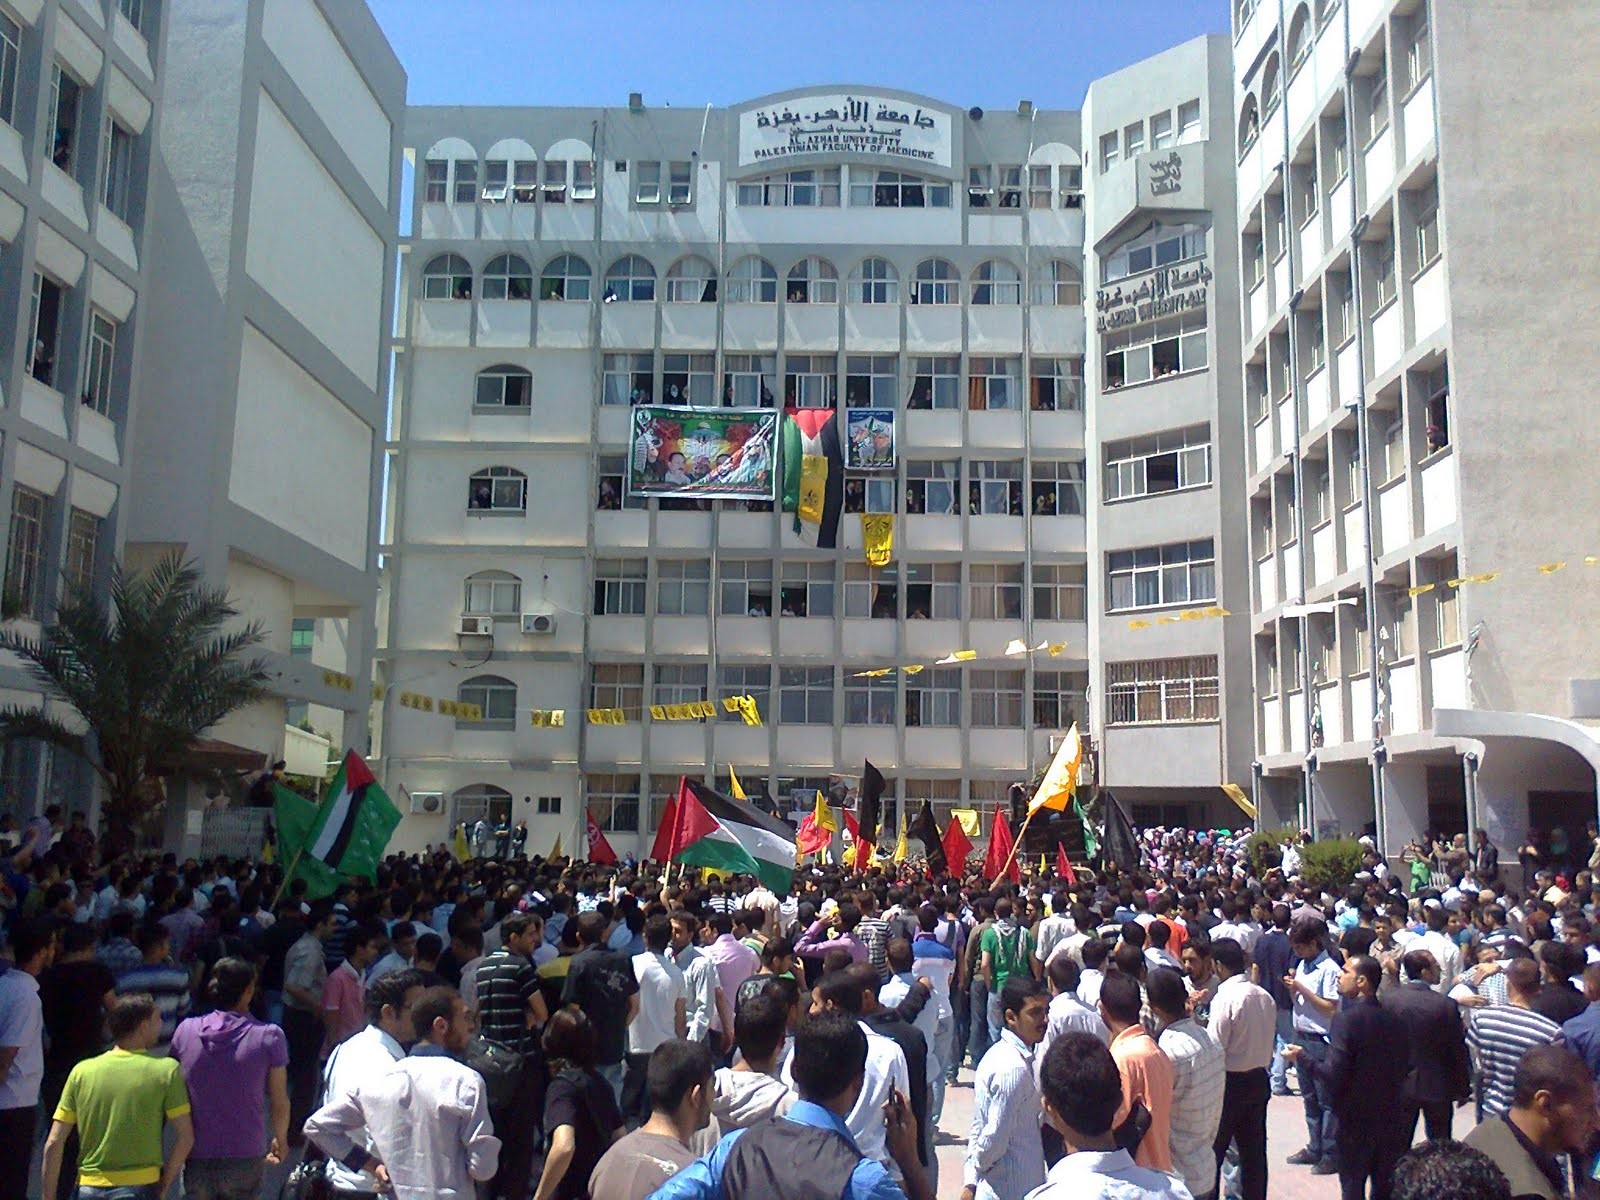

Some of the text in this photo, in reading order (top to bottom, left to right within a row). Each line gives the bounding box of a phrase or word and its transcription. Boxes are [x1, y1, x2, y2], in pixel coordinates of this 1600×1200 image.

[756, 107, 801, 128] بغزة
[811, 97, 868, 124] الأزهر
[876, 104, 935, 129] جامعة
[842, 135, 901, 146] UNIVERSITY
[753, 143, 935, 160] PALESTINIAN FACULTY OF MEDICINE
